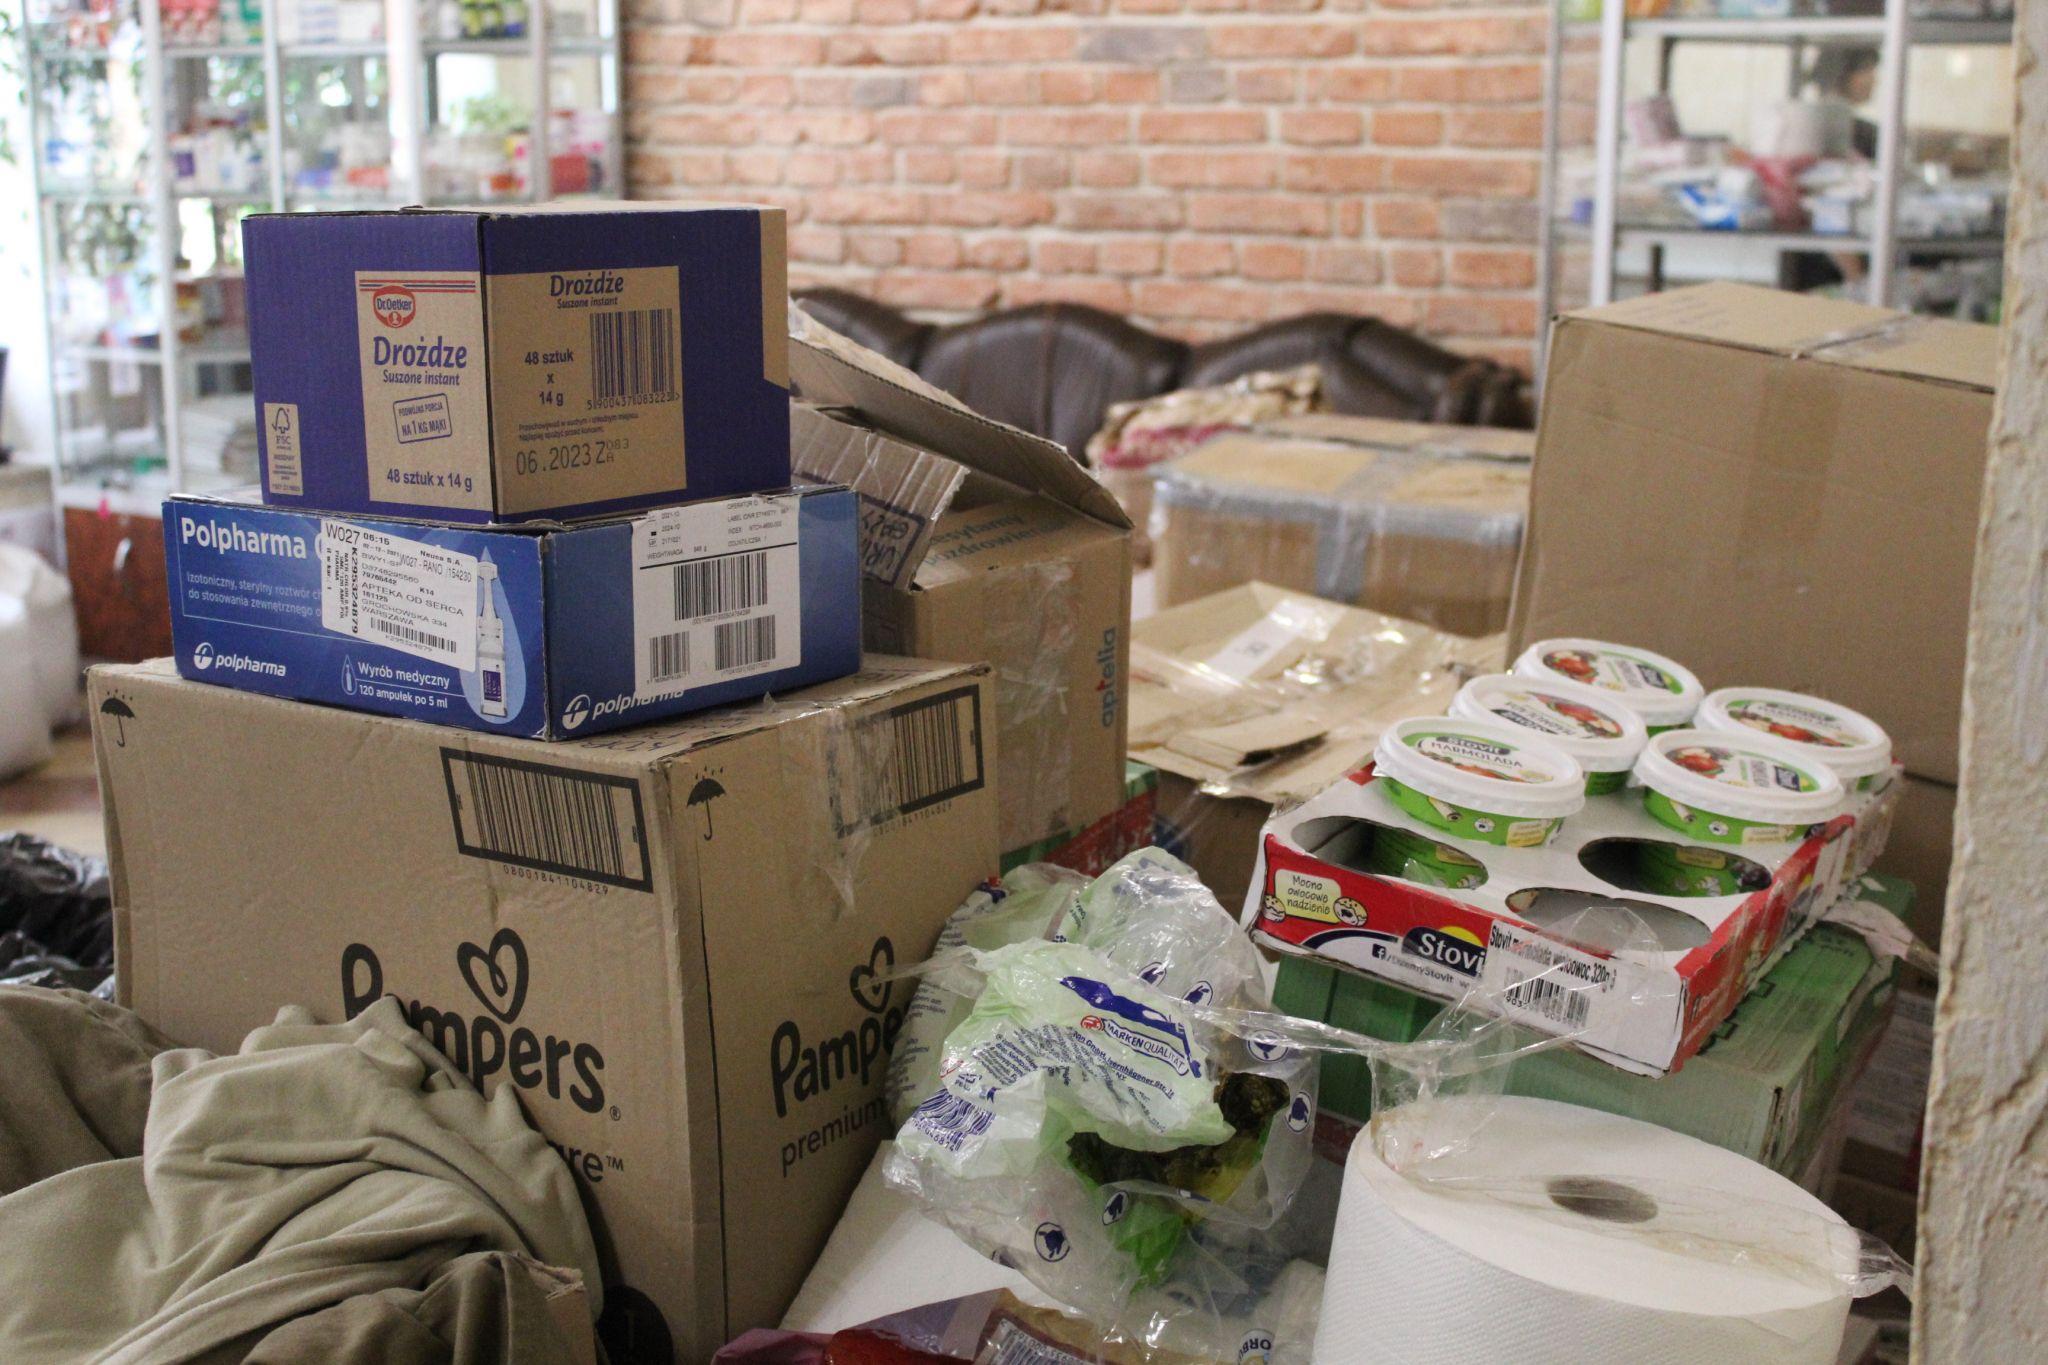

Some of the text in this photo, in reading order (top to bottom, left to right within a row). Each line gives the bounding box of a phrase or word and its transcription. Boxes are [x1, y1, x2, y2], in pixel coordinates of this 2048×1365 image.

[550, 271, 624, 297] Drożdże
[557, 296, 618, 309] Suszone instant
[525, 348, 574, 365] 48 sztuk
[383, 369, 460, 386] Suszone instant
[547, 373, 555, 384] x
[539, 391, 564, 407] 14 g
[402, 424, 412, 436] NA
[418, 421, 428, 434] KG
[429, 418, 447, 434] MĄKI
[387, 468, 473, 492] 48 sztuk x 14 g
[181, 517, 307, 559] Polpharma
[326, 522, 360, 545] W027
[186, 571, 237, 590] Izotoniczny,
[239, 580, 273, 595] sterylny
[275, 585, 310, 599] roztwór
[188, 589, 200, 599] do
[202, 591, 249, 607] stosowania
[251, 599, 313, 617] zewnętrznego
[361, 582, 464, 617] APTEKA OD SERCA
[361, 605, 414, 626] WARSZAWA
[215, 653, 286, 677] polpharma
[357, 662, 450, 690] Wyrób medyczny
[358, 684, 374, 696] 120
[415, 696, 427, 707] po
[429, 695, 435, 706] 5
[436, 697, 448, 709] ml
[1431, 742, 1522, 768] MARMOLADA
[1292, 875, 1323, 890] Mocno
[1287, 887, 1329, 904] owocowe
[1287, 899, 1331, 915] nadzienie
[1490, 925, 1512, 951] Stovit
[1418, 932, 1486, 973] Stovi
[341, 942, 605, 1114] Pmpers
[771, 1006, 903, 1119] Pampe
